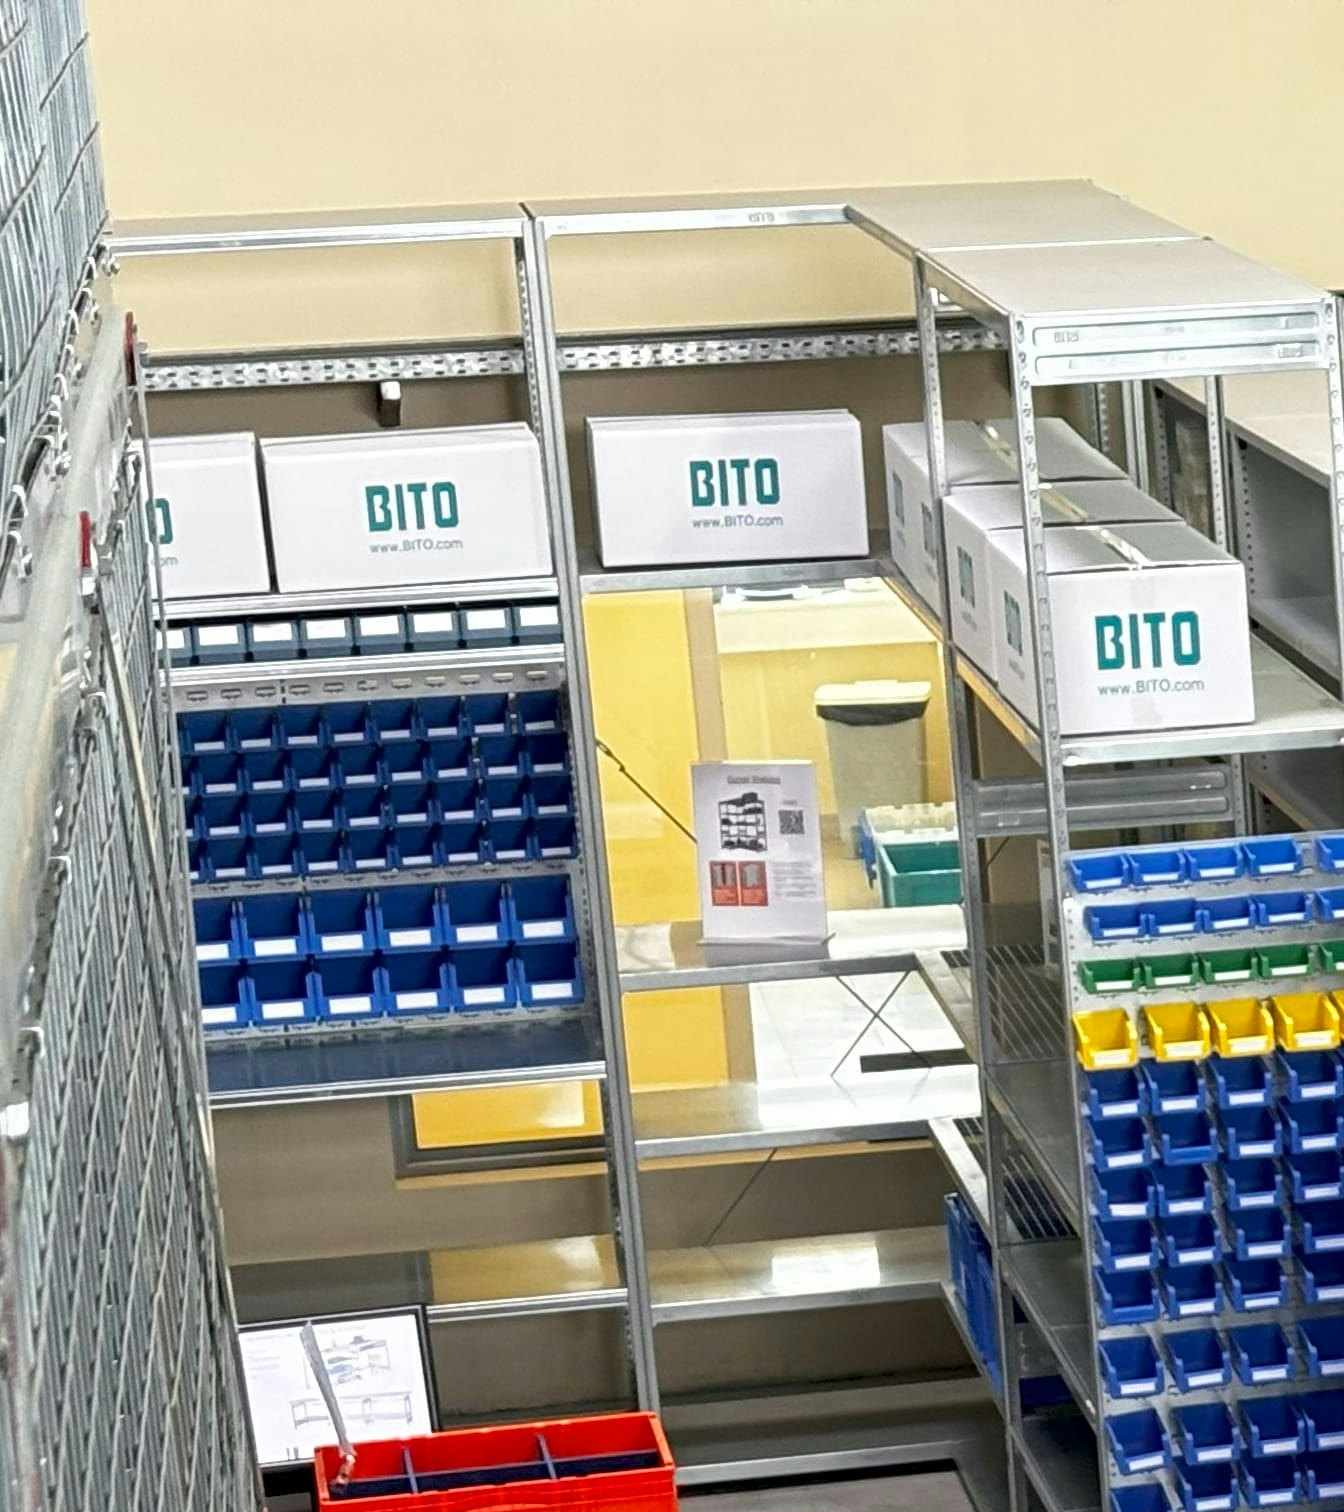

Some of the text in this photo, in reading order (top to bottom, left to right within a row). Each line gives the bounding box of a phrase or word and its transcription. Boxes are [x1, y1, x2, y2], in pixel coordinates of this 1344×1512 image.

[689, 458, 780, 507] BITO
[365, 481, 459, 532] BITO
[691, 514, 783, 529] www.BITO.com
[369, 538, 463, 553] www.BITO.com
[1095, 610, 1201, 670] BITO
[1097, 678, 1205, 696] www.BITO.com
